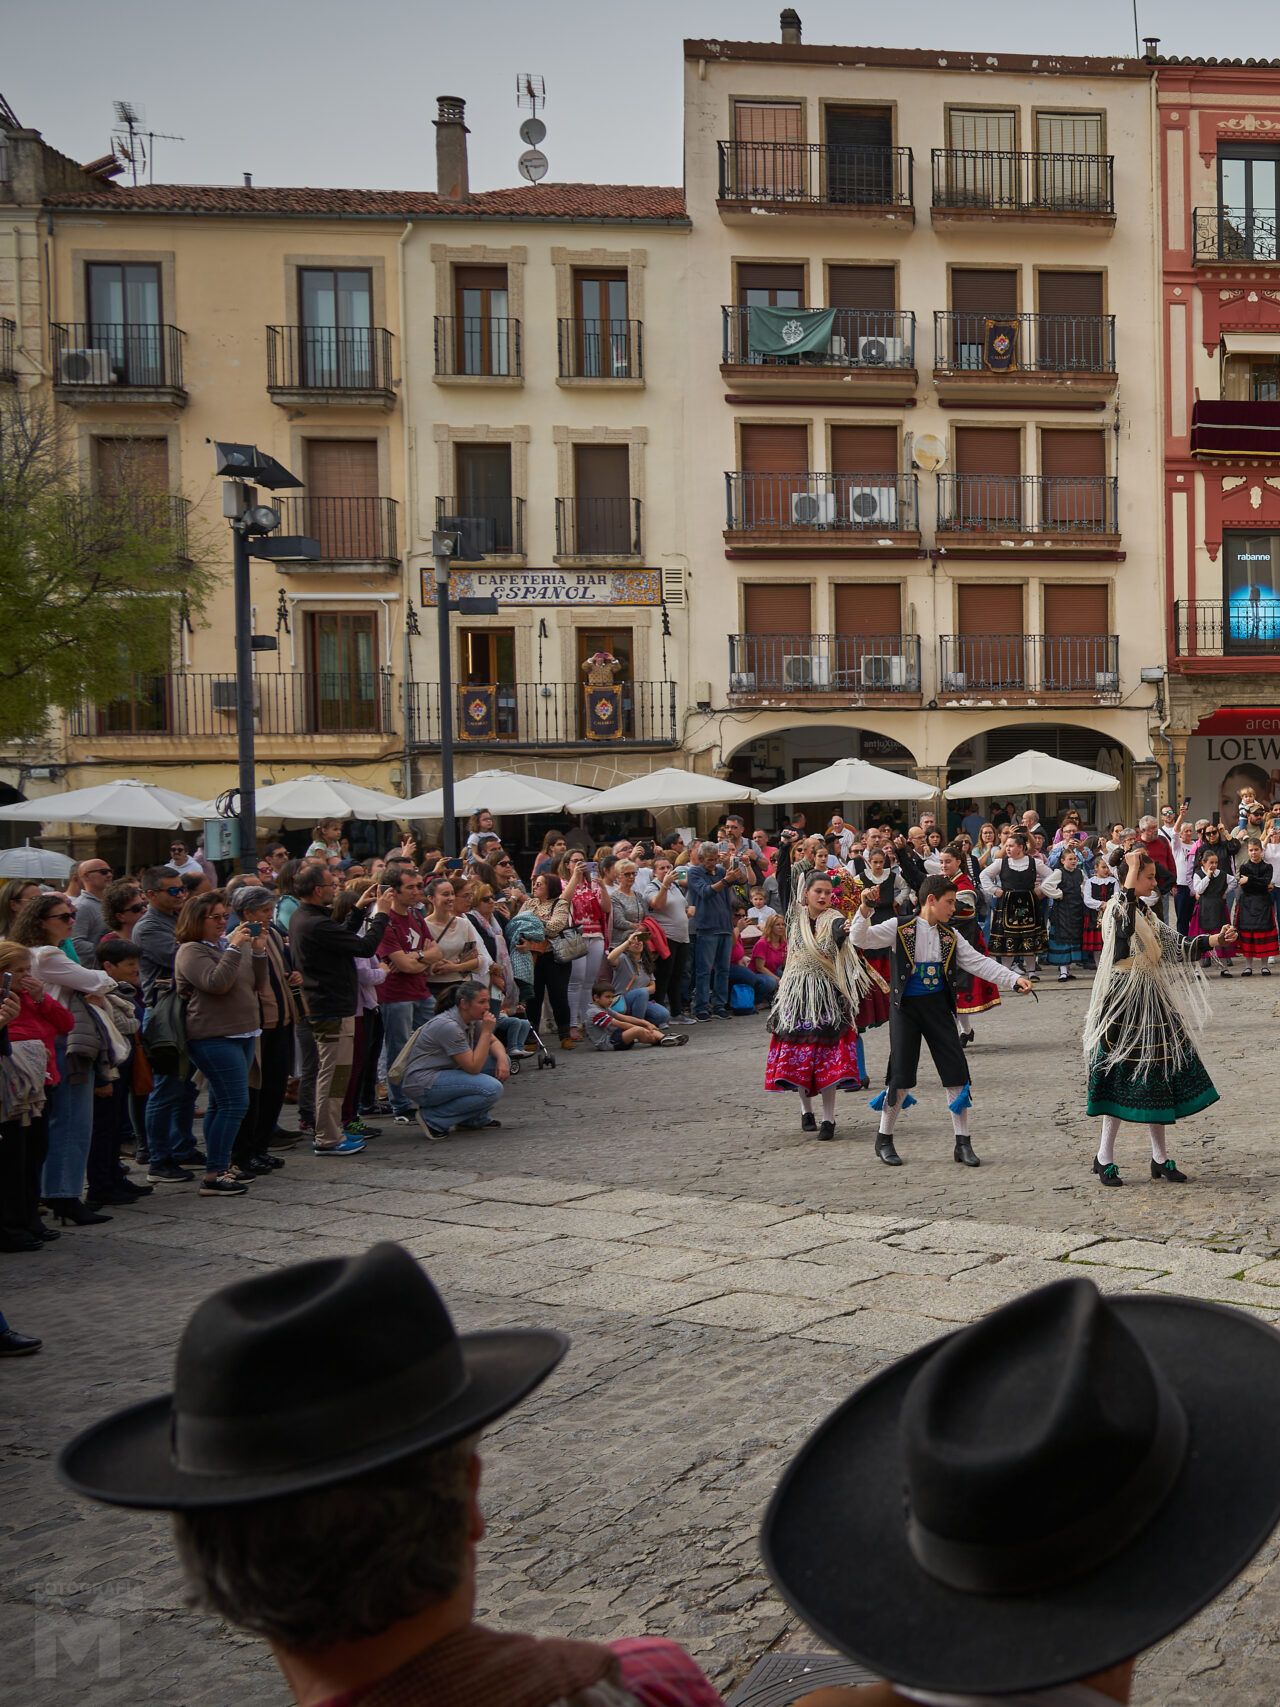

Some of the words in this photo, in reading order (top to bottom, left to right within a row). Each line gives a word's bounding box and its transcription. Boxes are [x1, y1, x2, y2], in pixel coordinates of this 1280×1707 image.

[1237, 553, 1271, 561] rabanne
[477, 574, 567, 585] CAFETERIA
[576, 574, 607, 585] BAR
[490, 585, 596, 600] ESPAÑOL
